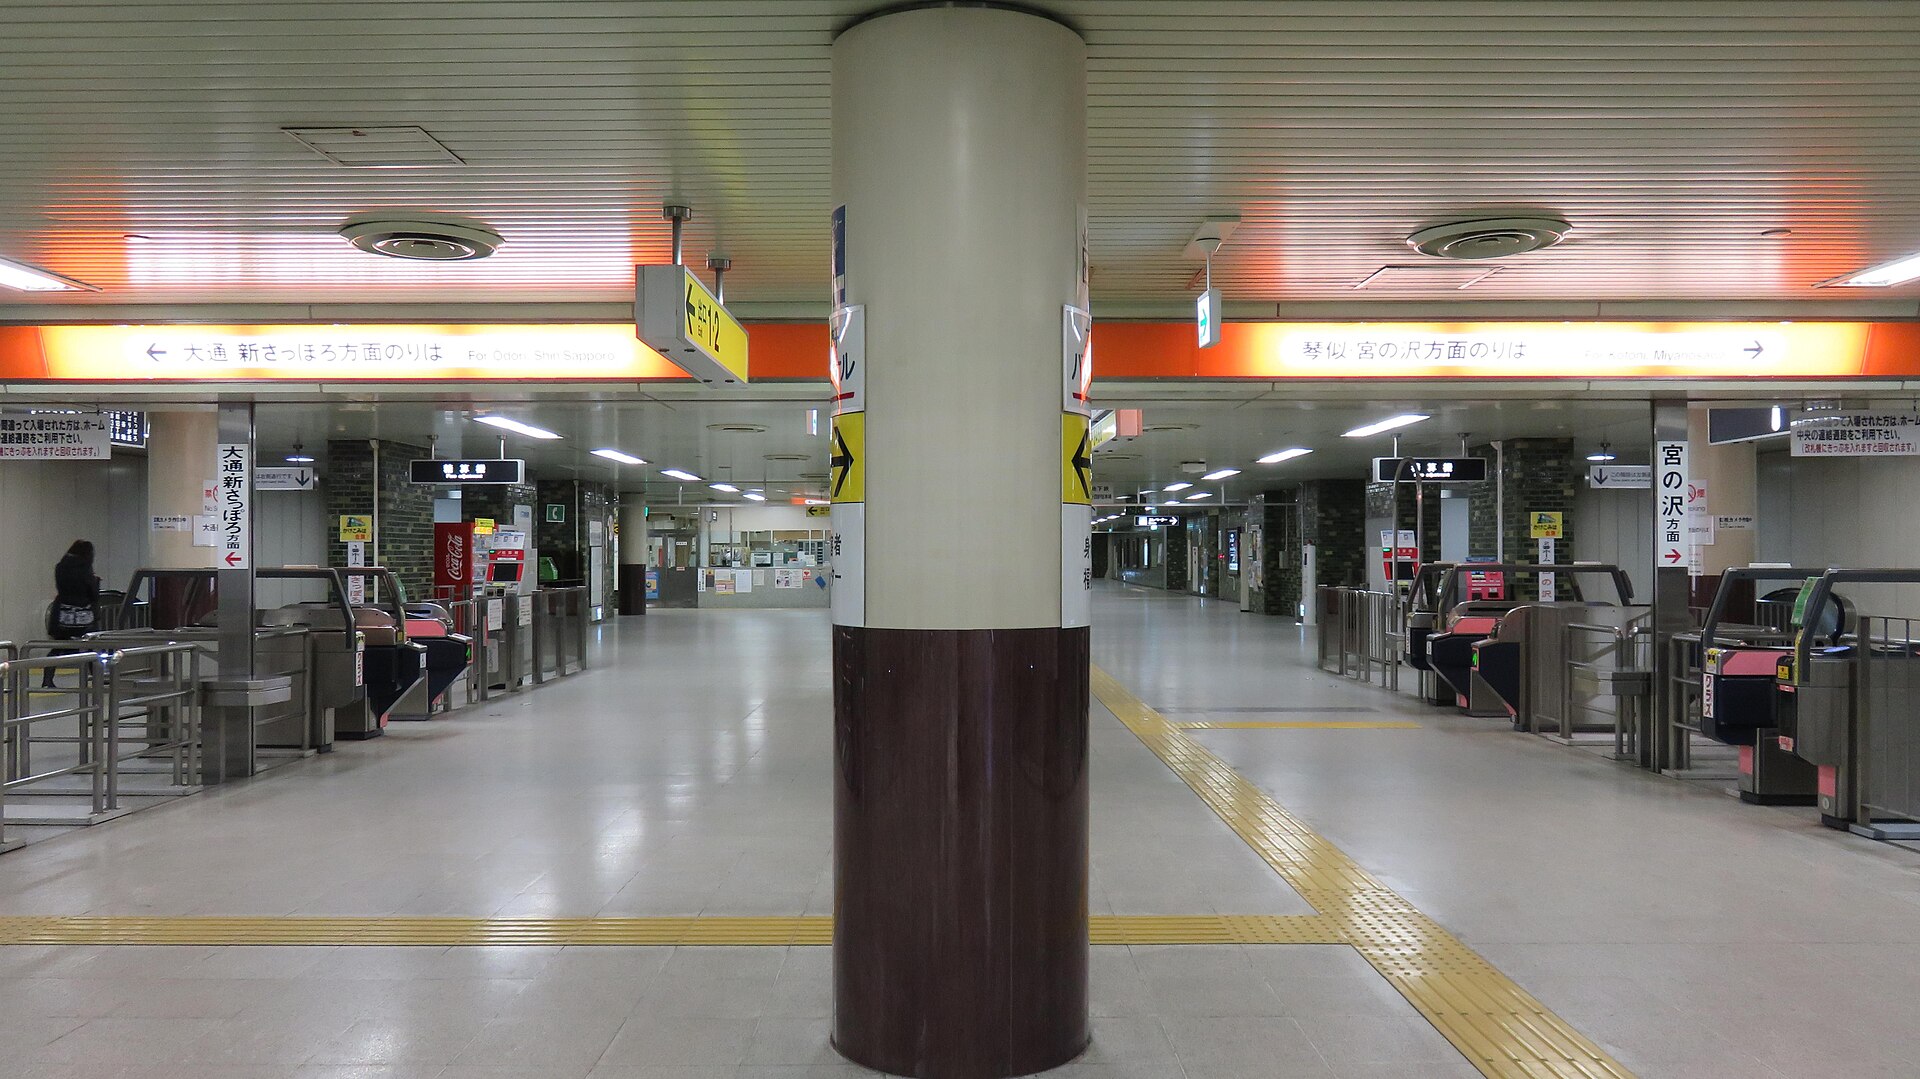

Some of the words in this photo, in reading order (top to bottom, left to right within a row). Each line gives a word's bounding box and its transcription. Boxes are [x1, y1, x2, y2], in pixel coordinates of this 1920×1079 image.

[1662, 445, 1683, 543] 宮の沢方面
